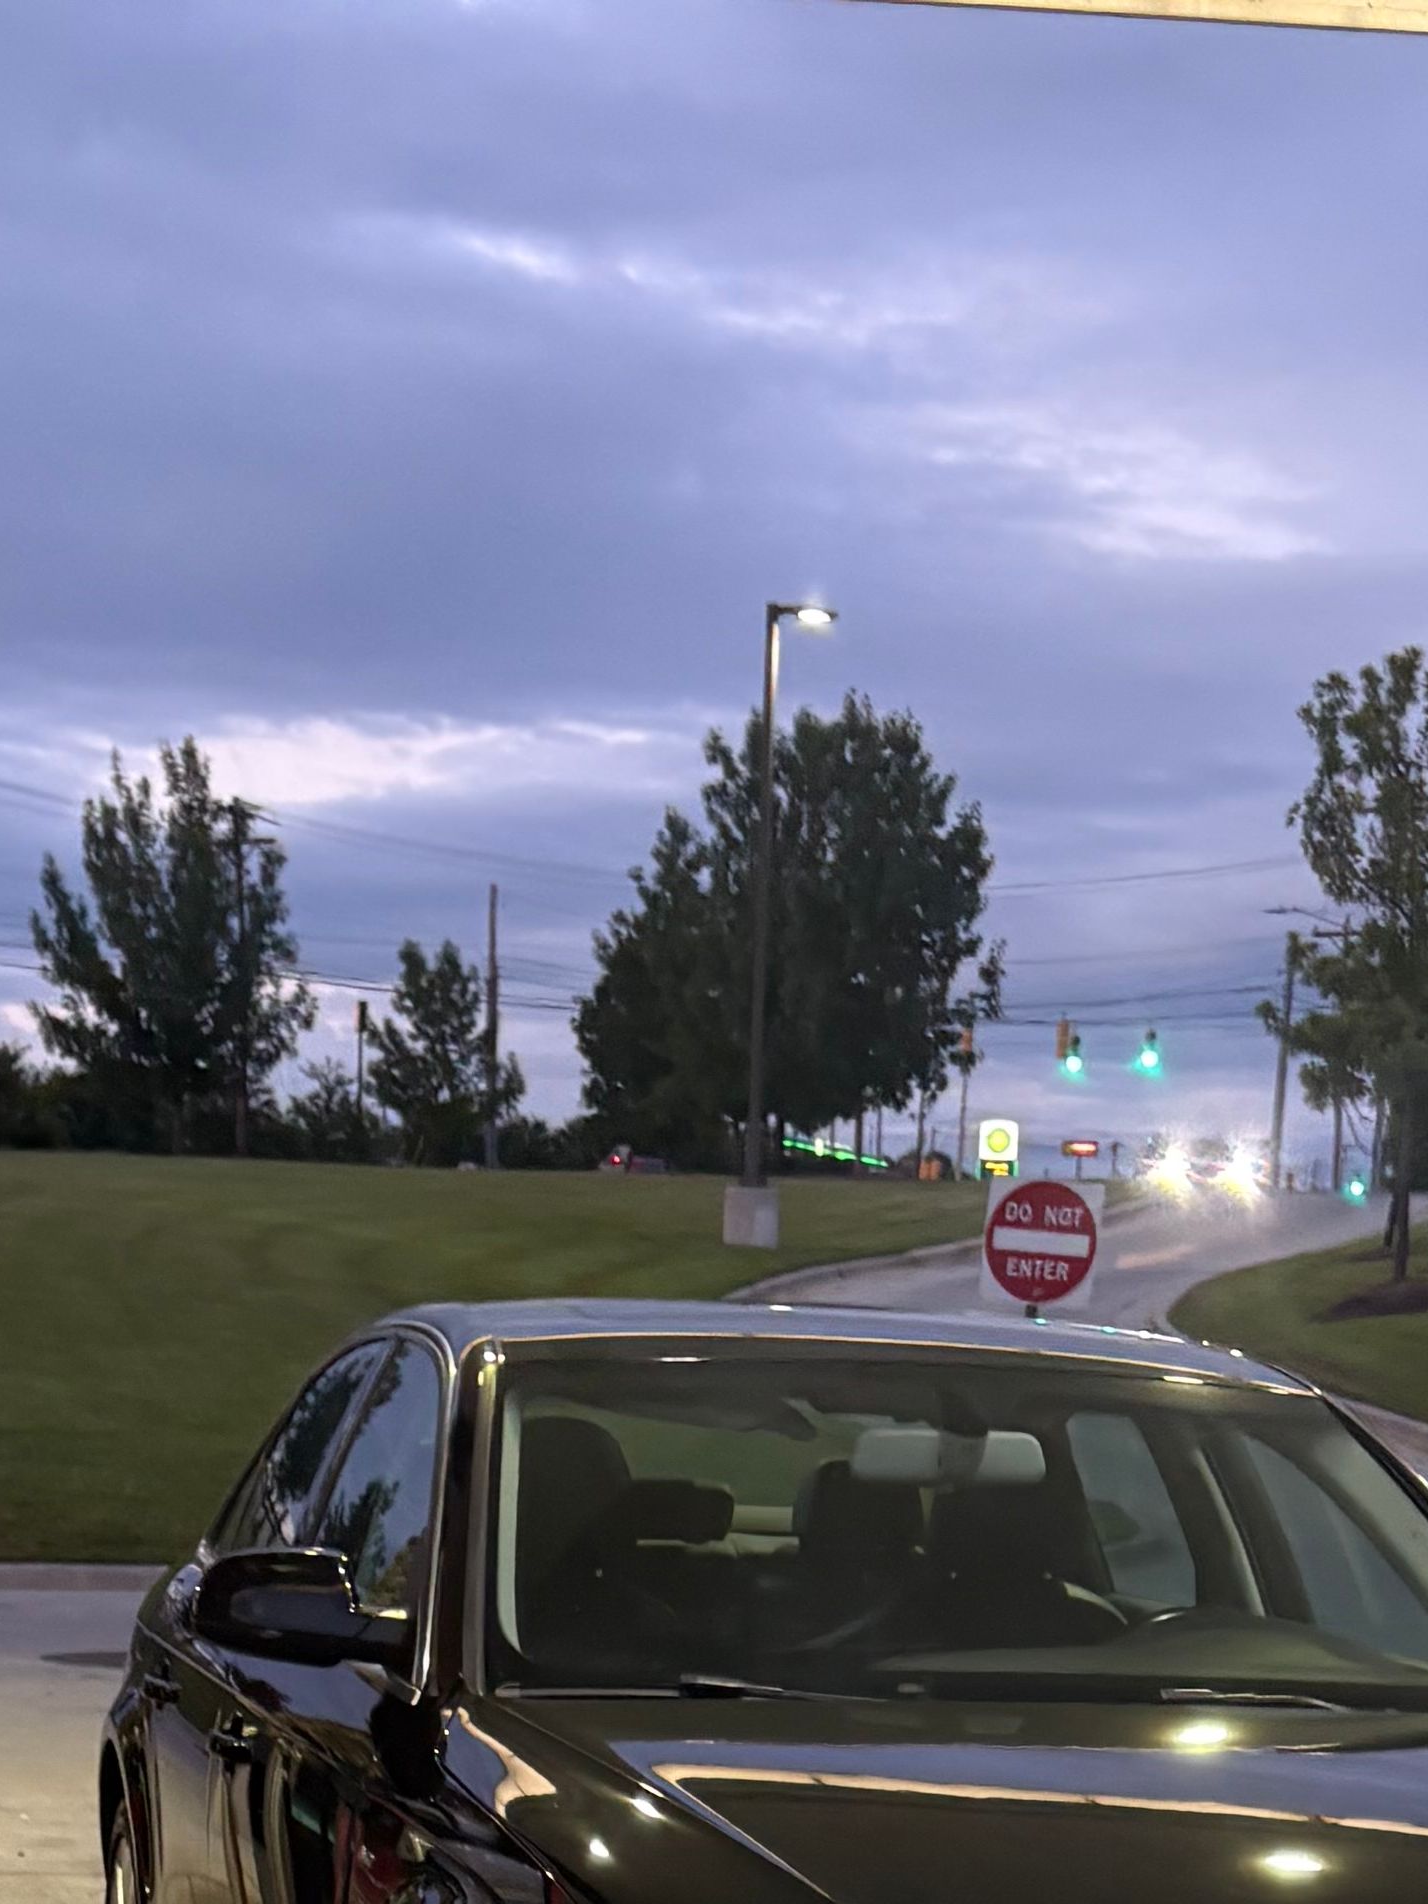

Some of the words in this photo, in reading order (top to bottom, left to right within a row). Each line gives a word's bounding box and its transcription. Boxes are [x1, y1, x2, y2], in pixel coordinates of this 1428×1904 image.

[1005, 1201, 1032, 1222] DO
[1044, 1205, 1085, 1227] NOT
[1006, 1256, 1070, 1281] ENTER
